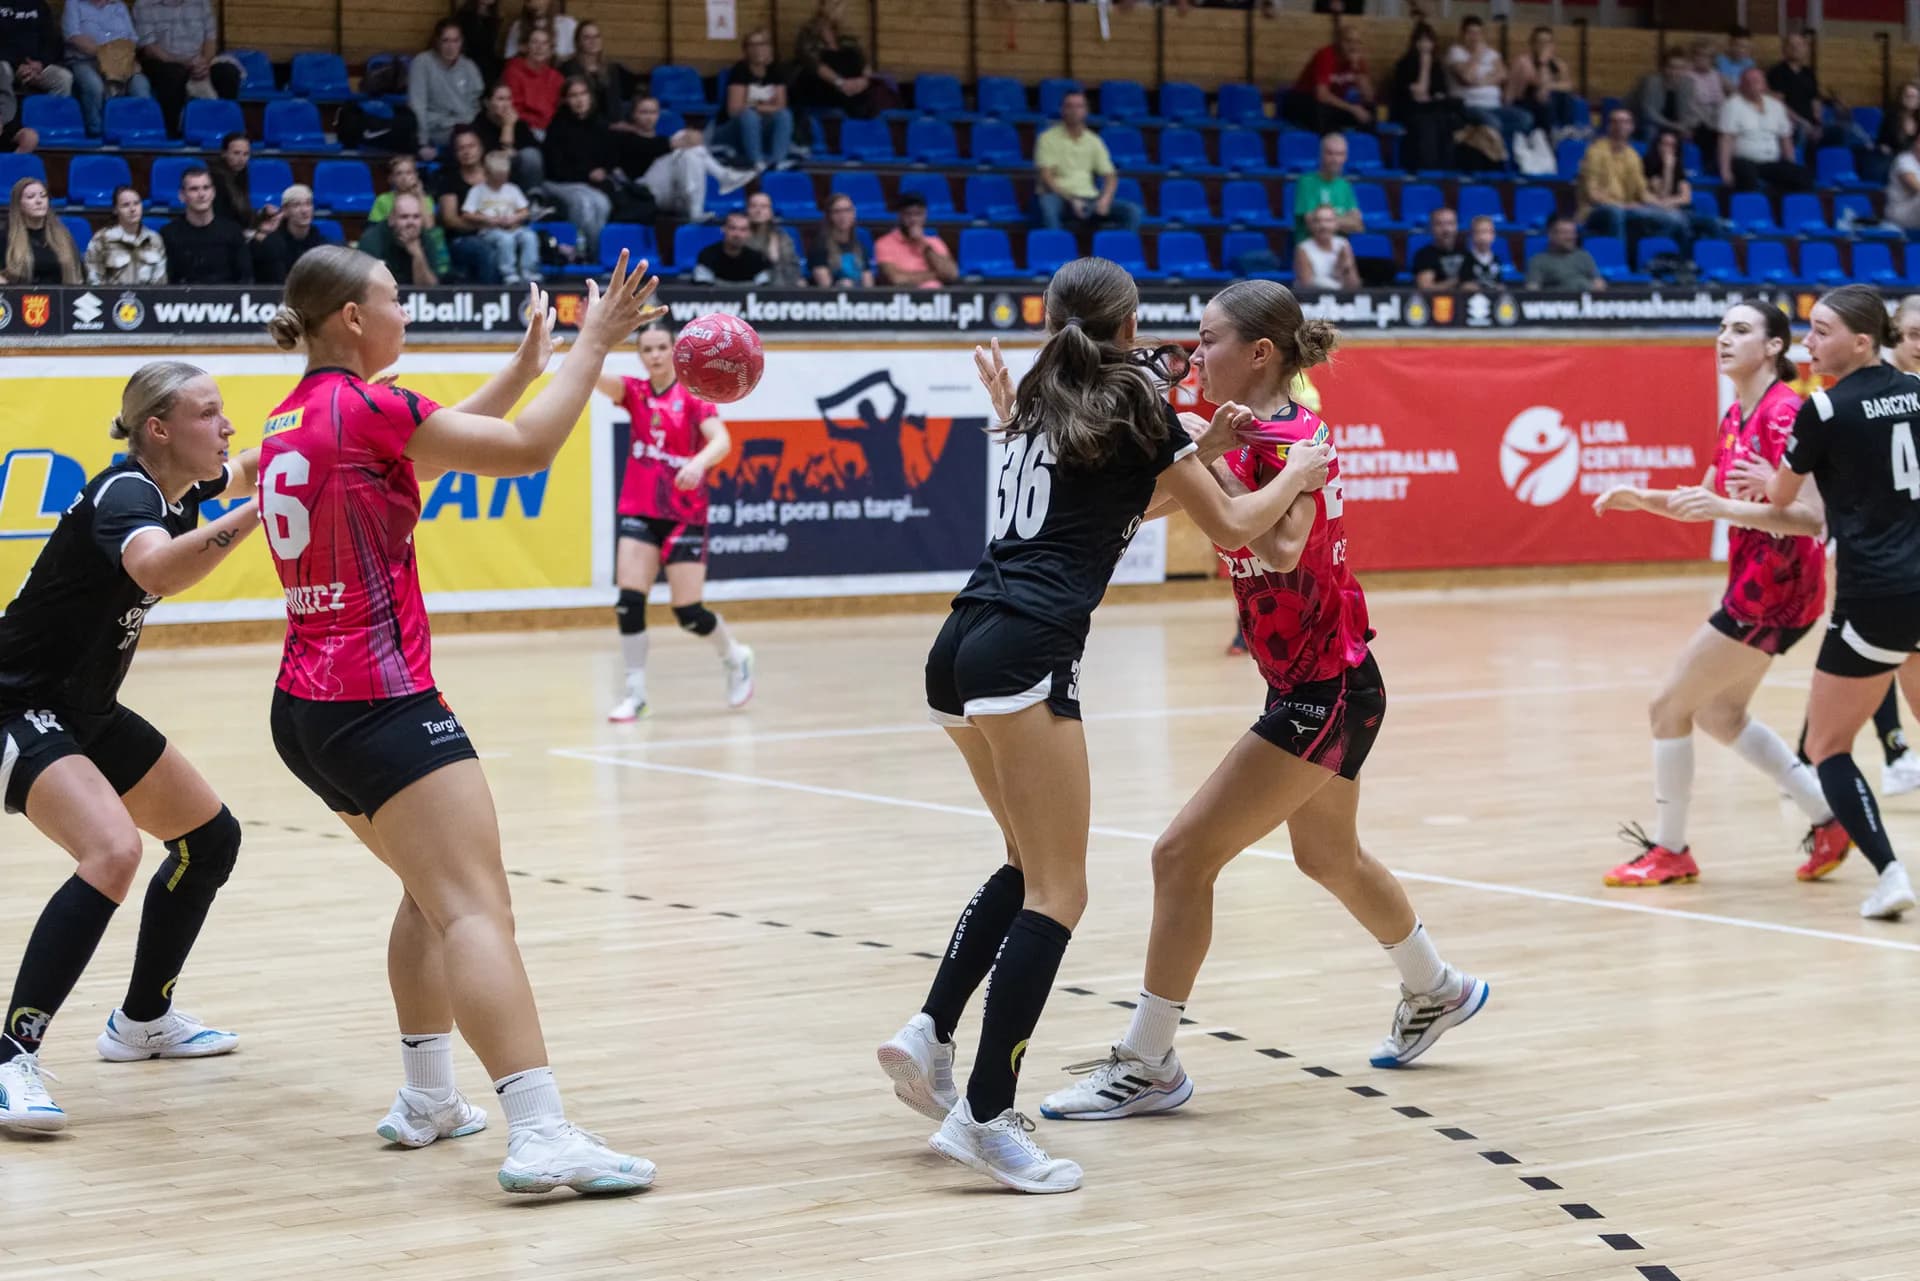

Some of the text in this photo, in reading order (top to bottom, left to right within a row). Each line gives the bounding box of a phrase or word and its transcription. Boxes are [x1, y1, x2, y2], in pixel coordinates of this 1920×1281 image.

[1333, 424, 1385, 449] LIGA
[1581, 421, 1628, 445] LIGA
[1581, 445, 1697, 470] CENTRALNA
[734, 500, 776, 527] jest
[780, 502, 830, 526] pora
[833, 501, 861, 519] na
[23, 709, 64, 734] 14
[422, 715, 457, 735] Targi
